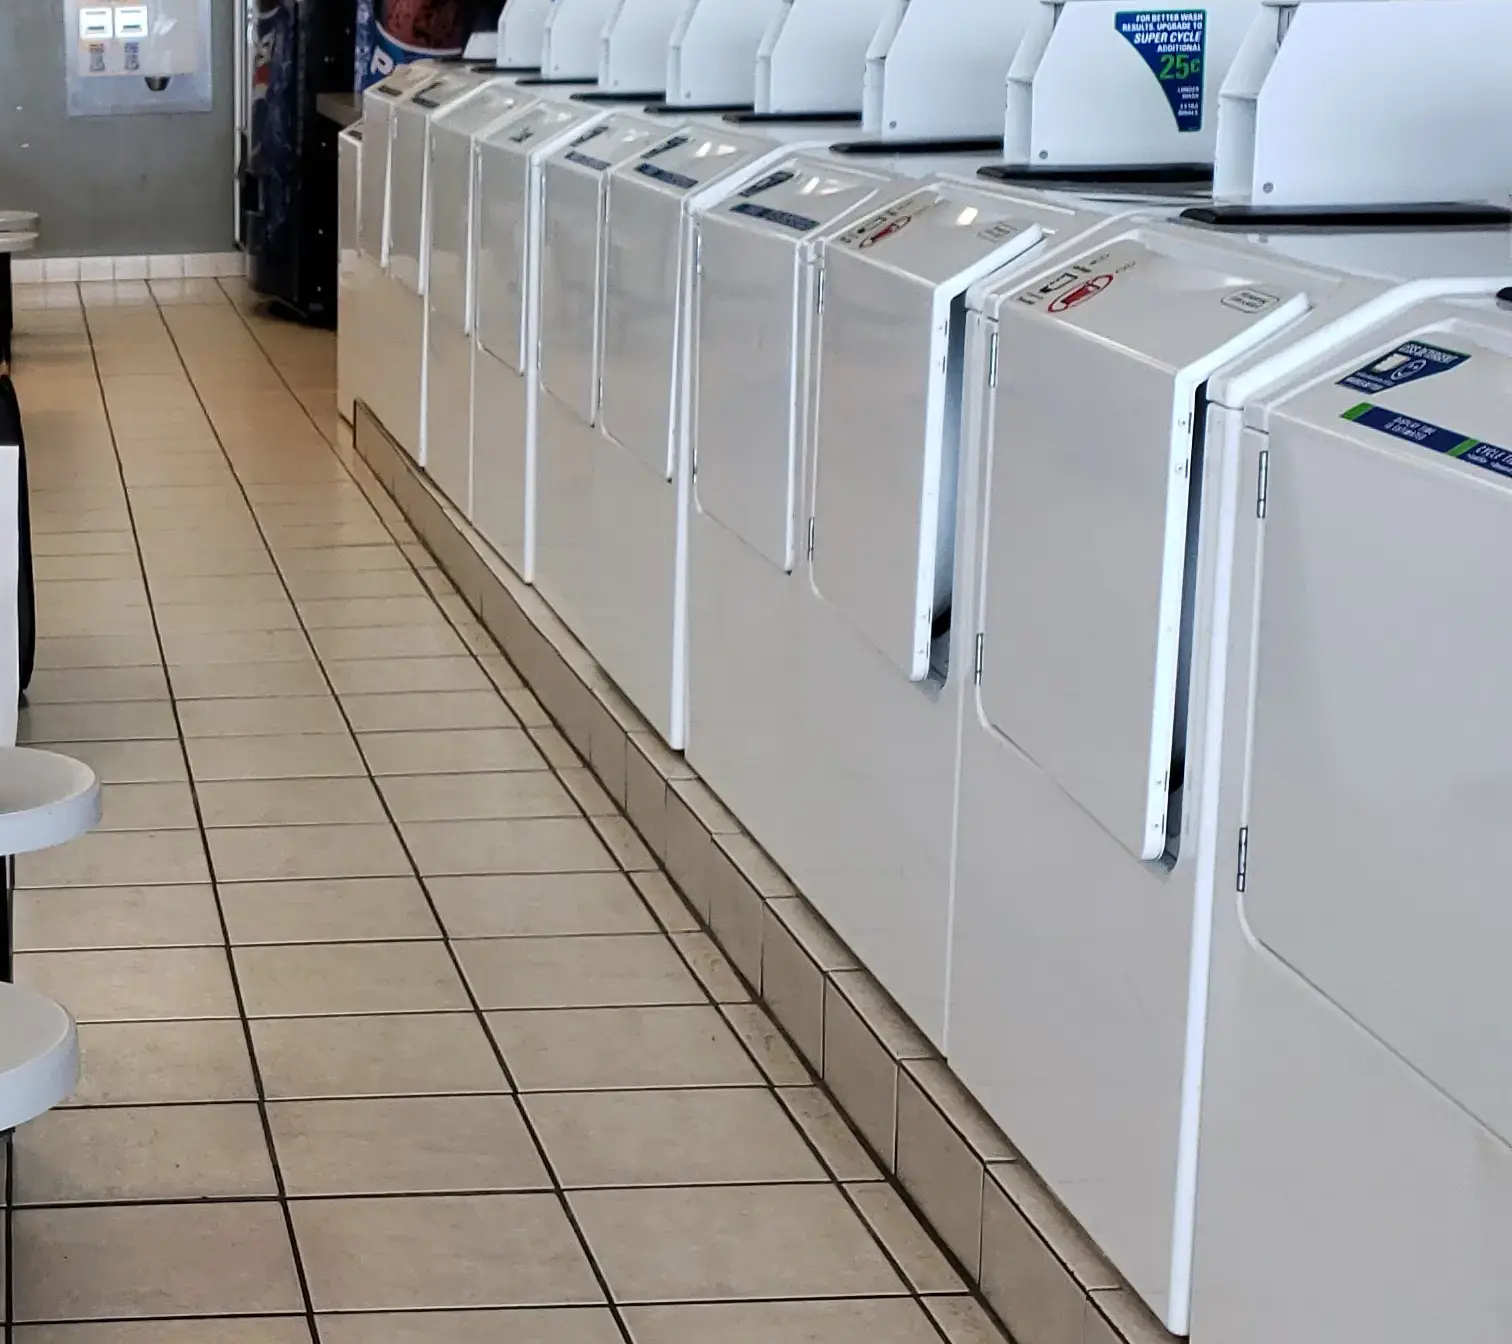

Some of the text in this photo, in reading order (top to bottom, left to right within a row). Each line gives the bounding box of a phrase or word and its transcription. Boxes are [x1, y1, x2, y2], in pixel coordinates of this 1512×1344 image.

[1136, 12, 1204, 23] FOR BETTER WASH
[1157, 21, 1191, 31] UPGRADE
[1193, 21, 1203, 30] TO
[1133, 31, 1202, 44] SUPER CYCLE
[1157, 44, 1201, 53] ADDITIONAL
